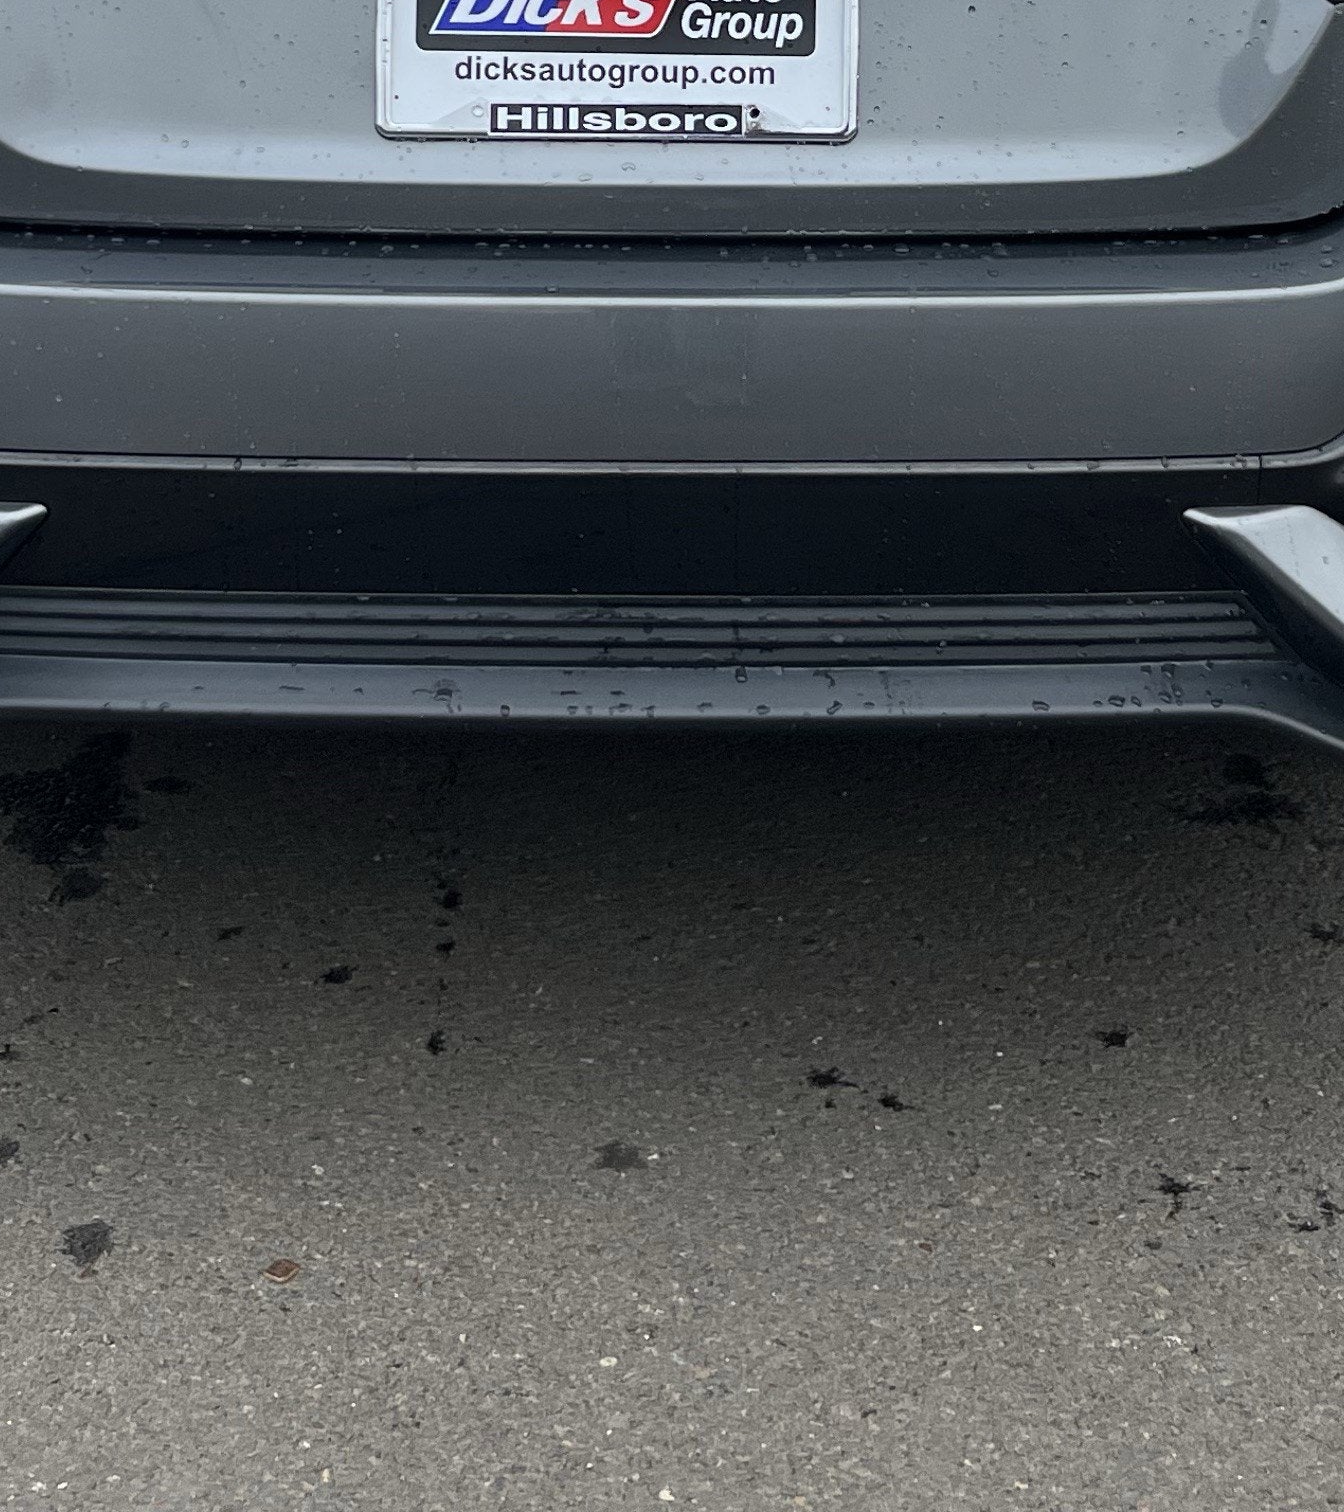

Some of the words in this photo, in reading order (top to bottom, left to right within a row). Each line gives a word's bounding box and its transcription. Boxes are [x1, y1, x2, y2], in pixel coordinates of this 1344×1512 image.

[680, 2, 804, 48] Group
[455, 56, 776, 90] dicksautogroup.com
[495, 106, 738, 133] Hillsboro
